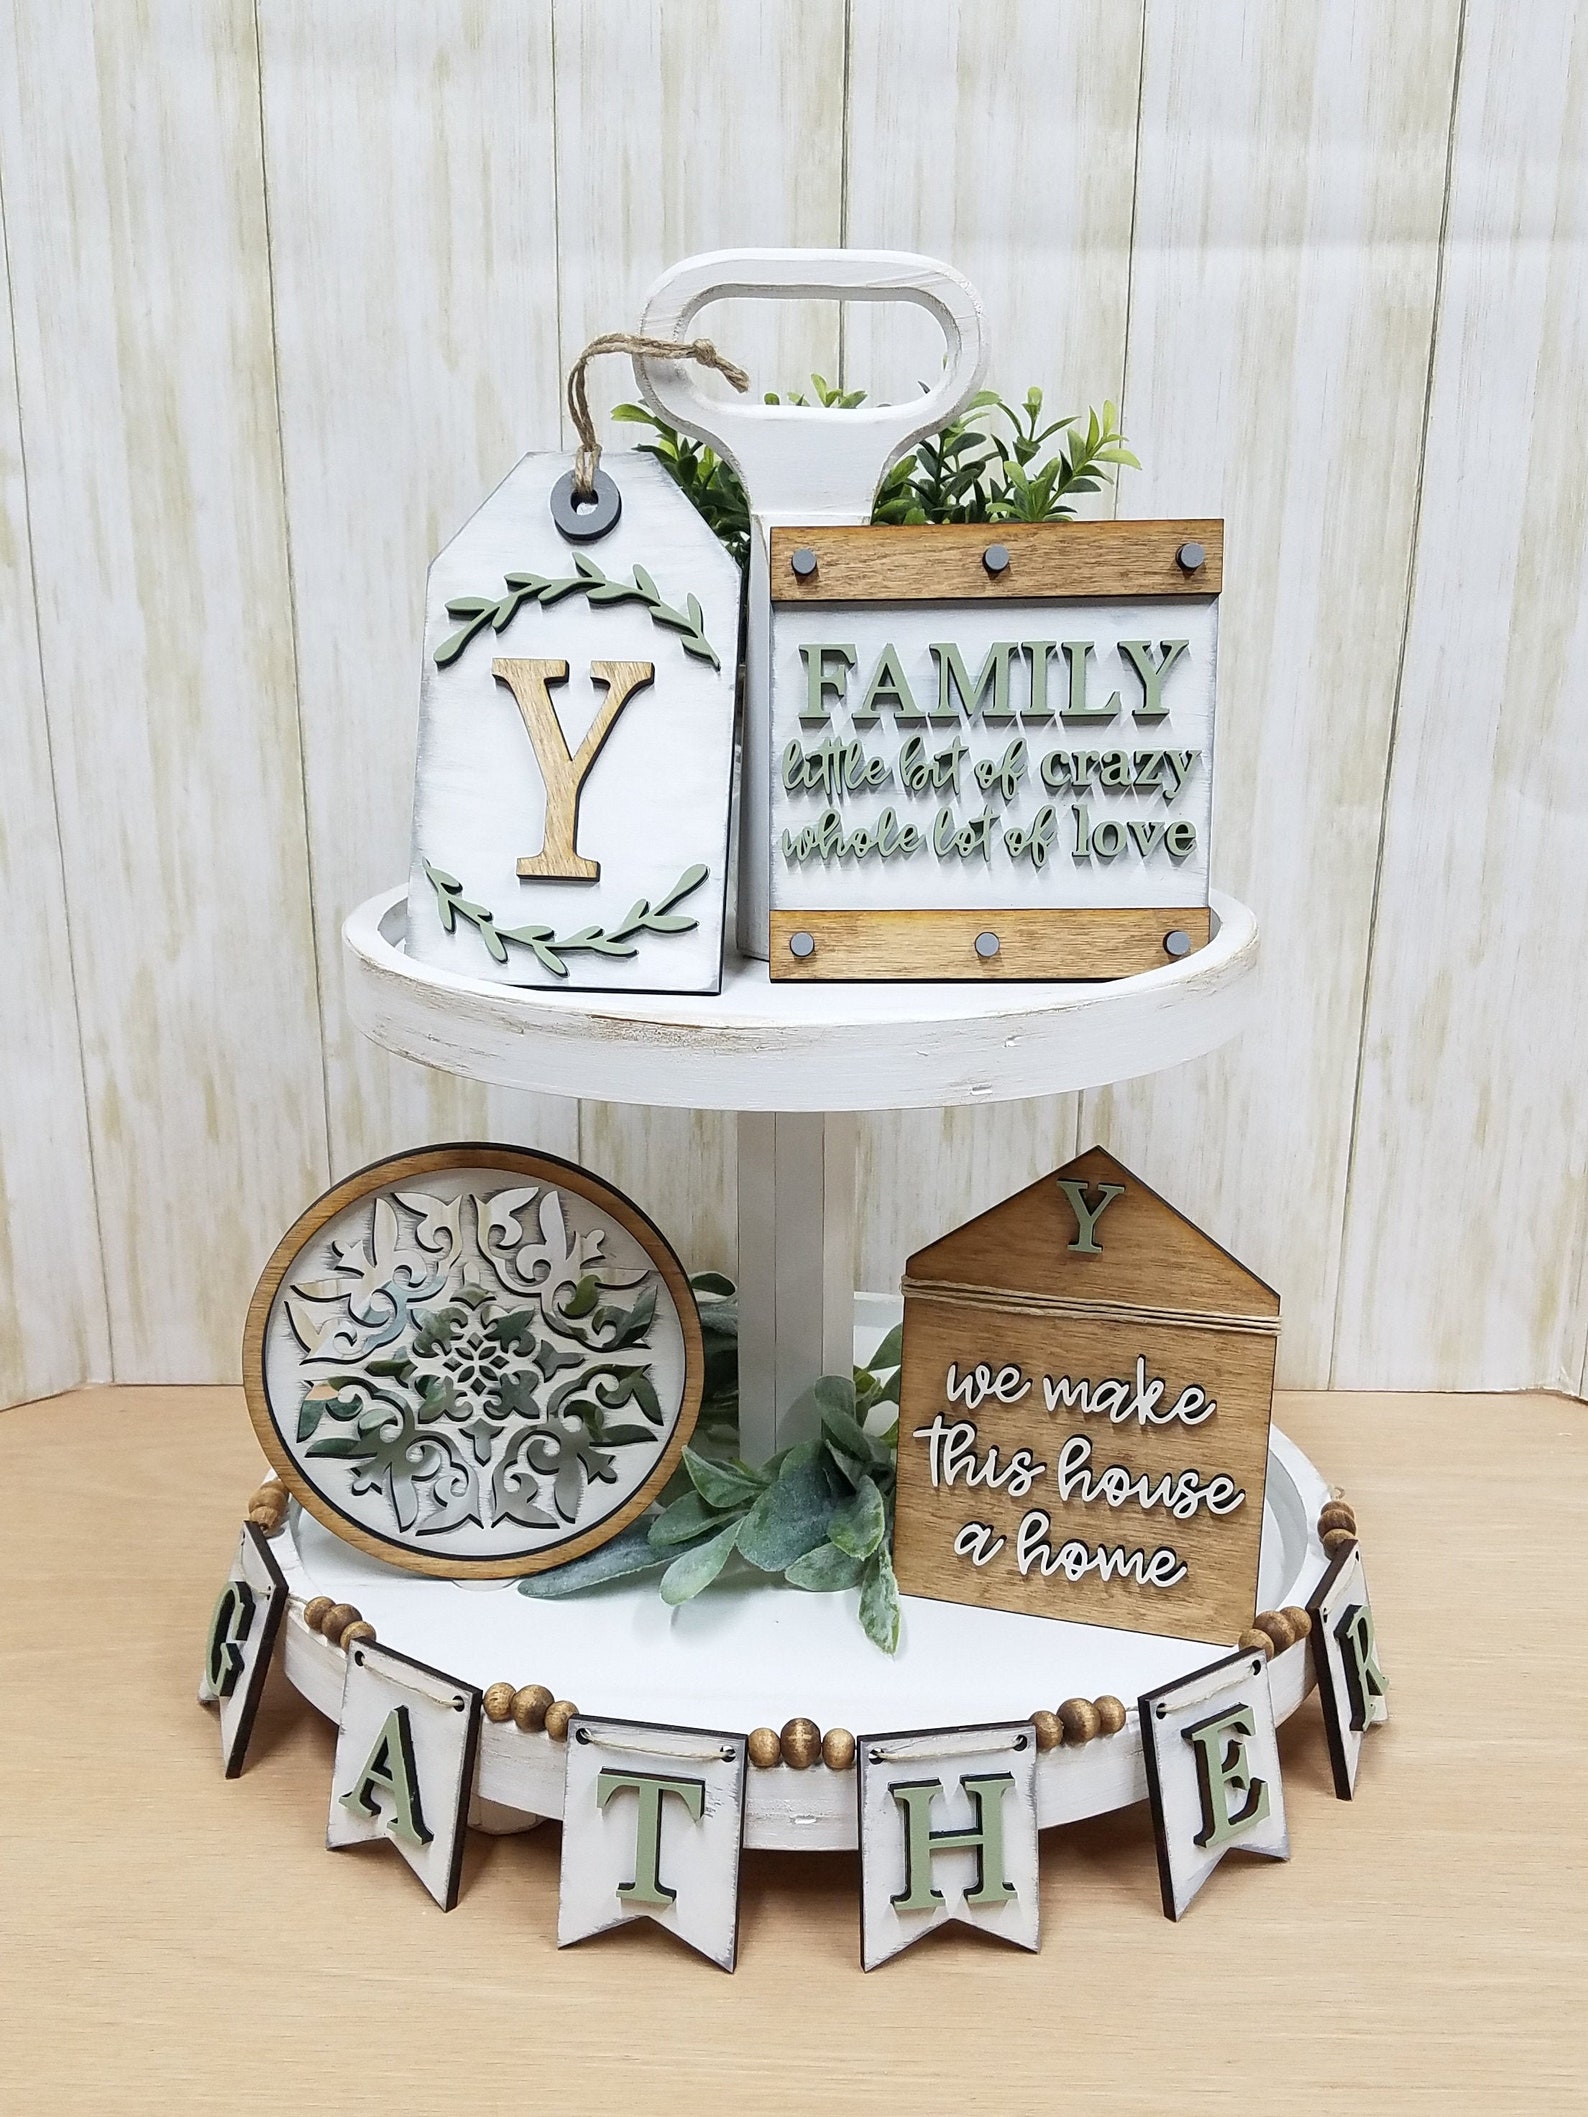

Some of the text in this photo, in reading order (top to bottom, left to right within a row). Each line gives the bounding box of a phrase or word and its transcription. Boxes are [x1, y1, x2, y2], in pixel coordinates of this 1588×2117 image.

[798, 639, 1190, 719] FAMILY
[492, 657, 655, 882] Y
[782, 735, 1201, 800] little bit of crazy
[782, 804, 1197, 868] whole lot of love
[1056, 1177, 1126, 1254] Y
[946, 1353, 1217, 1426] we make
[912, 1412, 1246, 1520] this house
[953, 1508, 1189, 1588] a home
